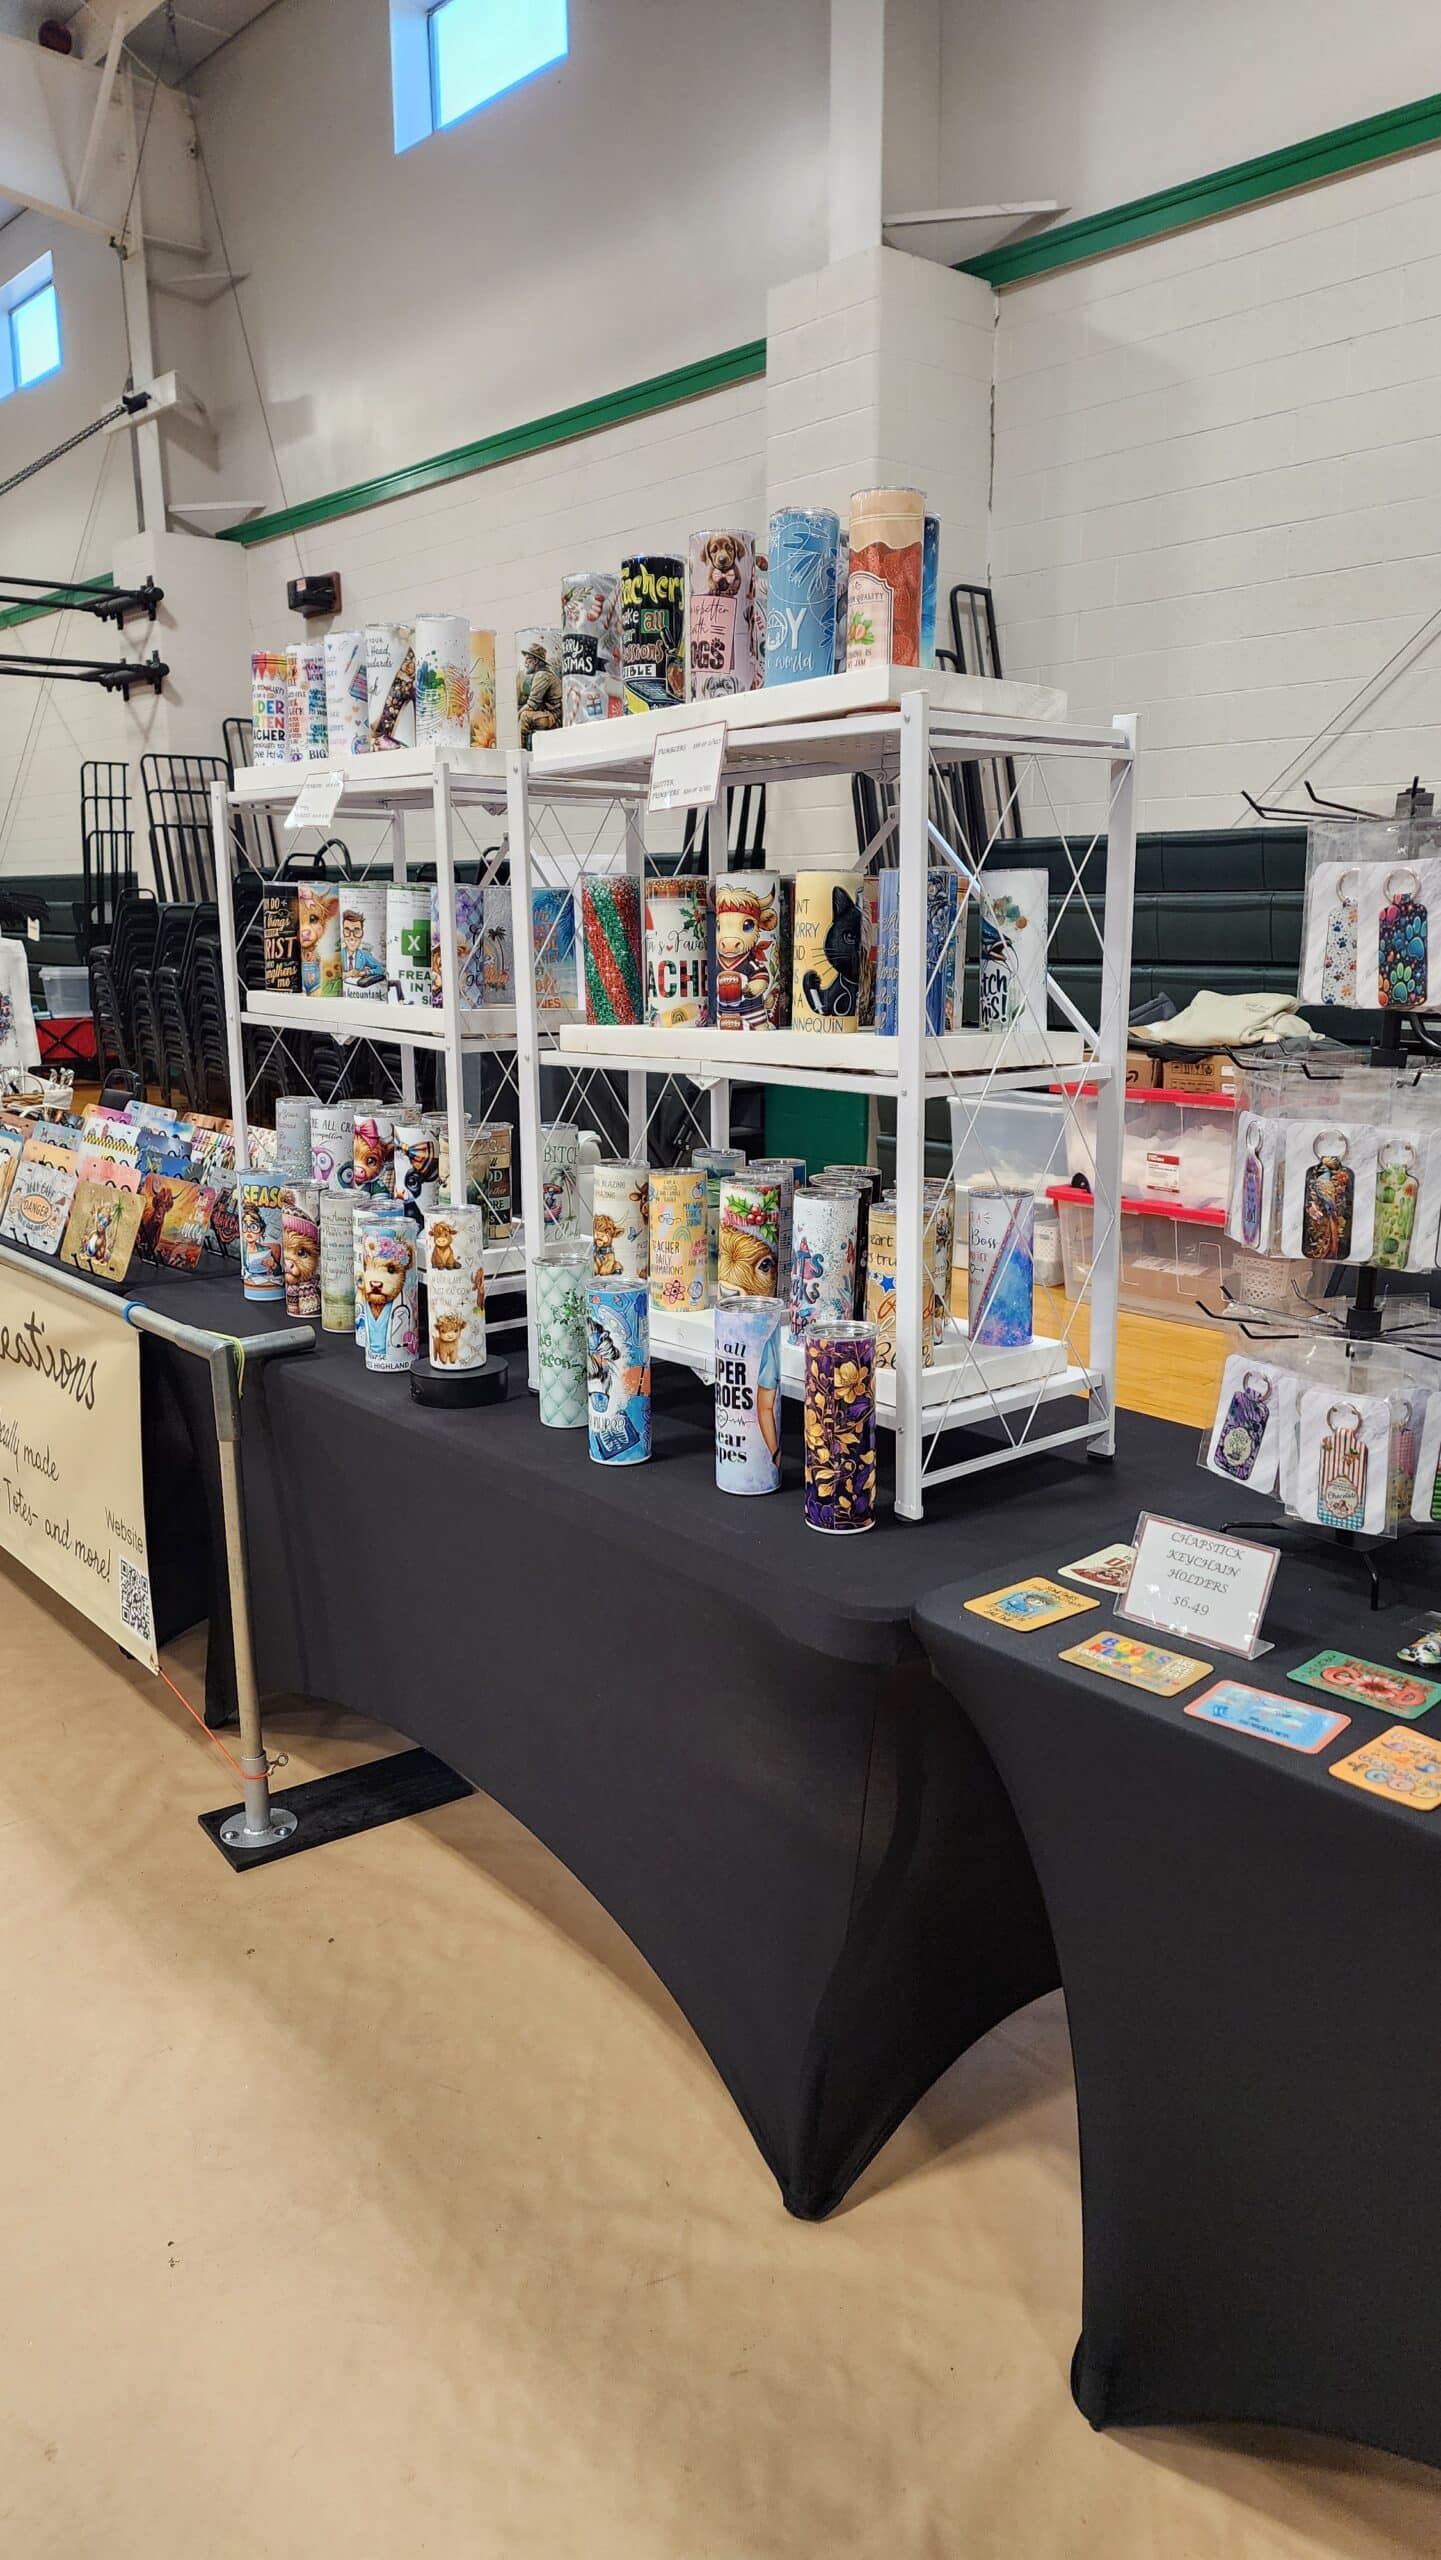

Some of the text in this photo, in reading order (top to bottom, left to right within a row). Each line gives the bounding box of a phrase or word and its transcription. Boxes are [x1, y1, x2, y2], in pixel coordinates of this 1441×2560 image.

[644, 611, 665, 631] all
[776, 651, 815, 673] world
[408, 935, 421, 952] X
[410, 983, 424, 993] IN
[322, 1120, 336, 1131] ALL
[23, 1199, 49, 1217] DANGER
[971, 1228, 996, 1249] Boss
[724, 1342, 747, 1358] all
[374, 1361, 410, 1370] HIGHLAND
[24, 1445, 60, 1482] made
[3, 1477, 112, 1583] Totes- and more!
[105, 1506, 144, 1555] Website
[1171, 1531, 1246, 1561] CHAPSTICK
[1166, 1549, 1242, 1578] KEYCHAIN
[1167, 1568, 1230, 1595] HOLDERS
[1172, 1594, 1210, 1617] $6.49
